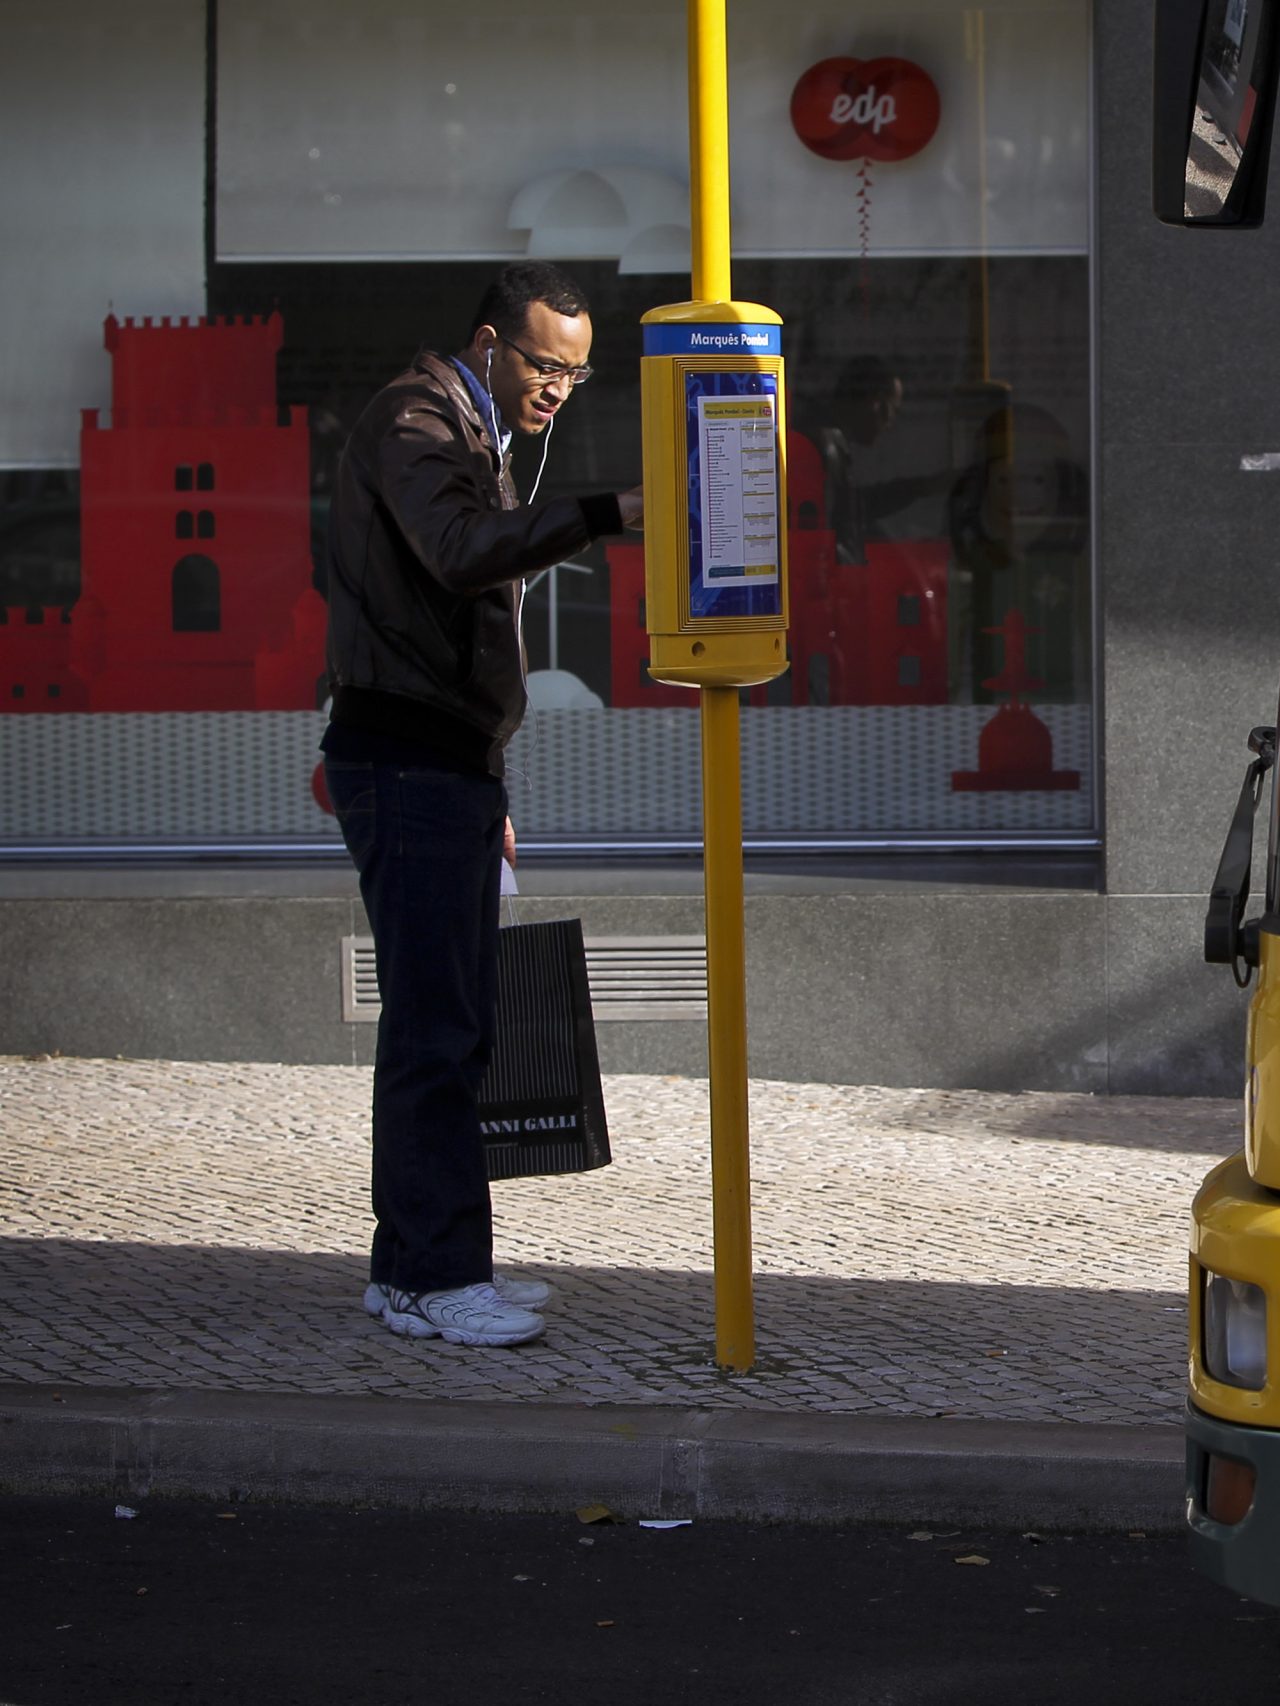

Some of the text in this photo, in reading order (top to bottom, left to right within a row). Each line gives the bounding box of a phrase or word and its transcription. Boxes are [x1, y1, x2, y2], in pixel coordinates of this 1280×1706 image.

[828, 84, 897, 135] edp
[741, 333, 769, 346] Pombal
[524, 1114, 577, 1131] GALLI
